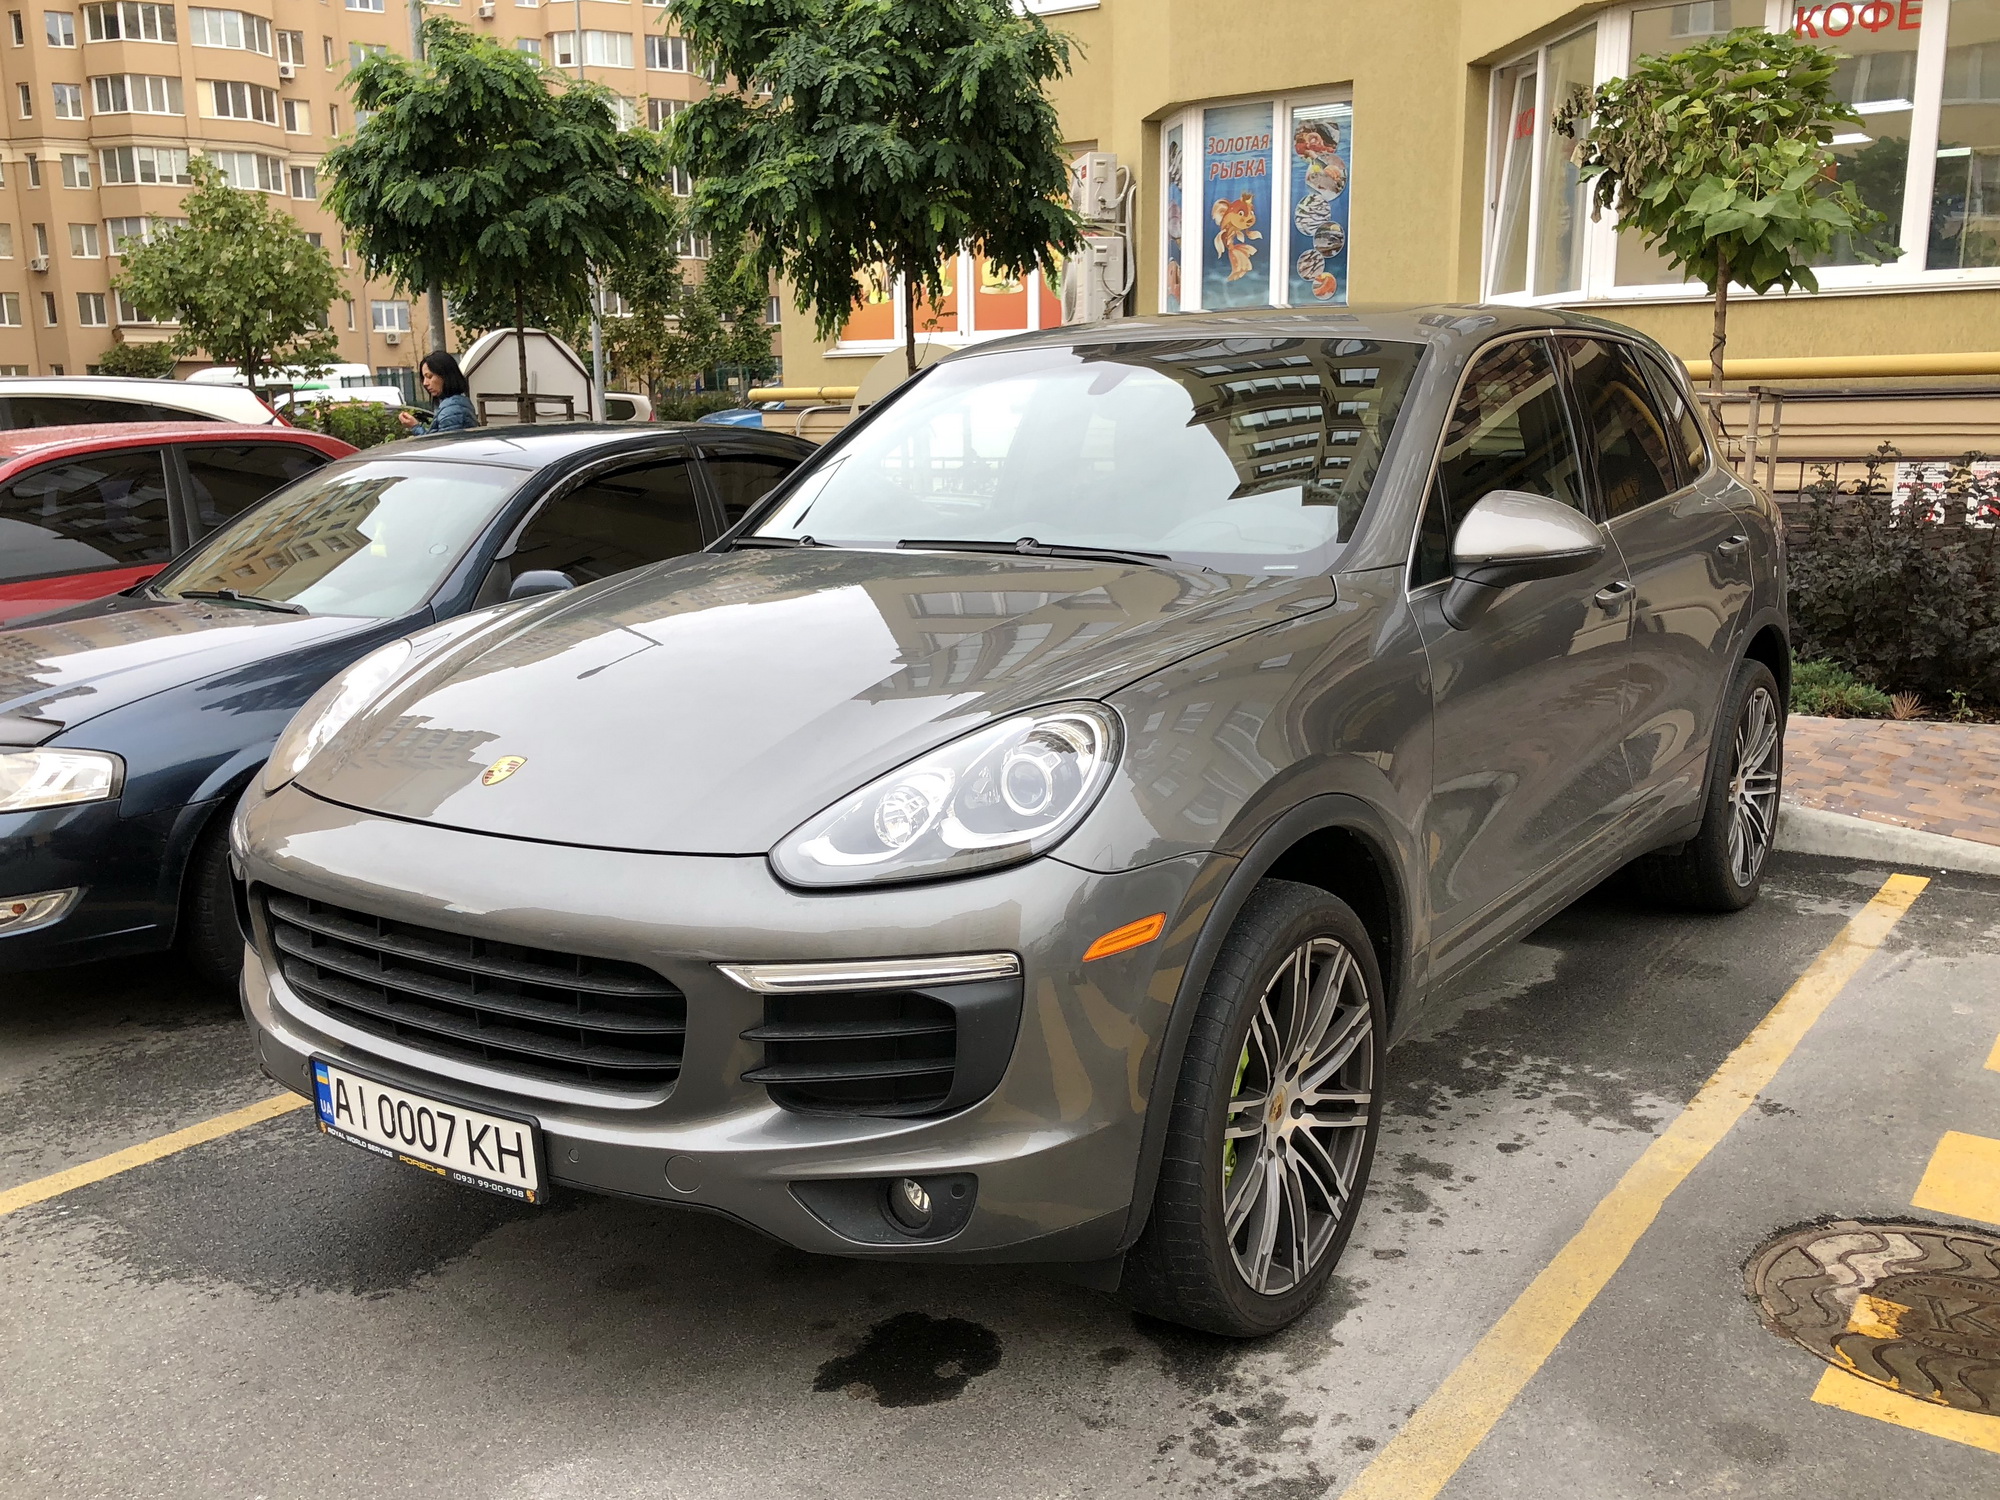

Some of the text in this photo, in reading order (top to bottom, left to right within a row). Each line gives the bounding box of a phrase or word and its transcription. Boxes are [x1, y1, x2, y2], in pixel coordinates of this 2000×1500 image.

[1795, 0, 1922, 40] КОФЕ
[1206, 134, 1270, 155] ЗОЛОТАЯ
[1209, 158, 1265, 180] РЫБКА
[319, 1098, 333, 1116] UA
[377, 1093, 457, 1158] 0007
[465, 1118, 527, 1179] KH
[327, 1126, 346, 1140] ROYAL
[346, 1135, 367, 1148] WORLD
[367, 1143, 394, 1158] SERVICE
[399, 1154, 447, 1176] PORSCHE
[453, 1172, 476, 1185] (093)
